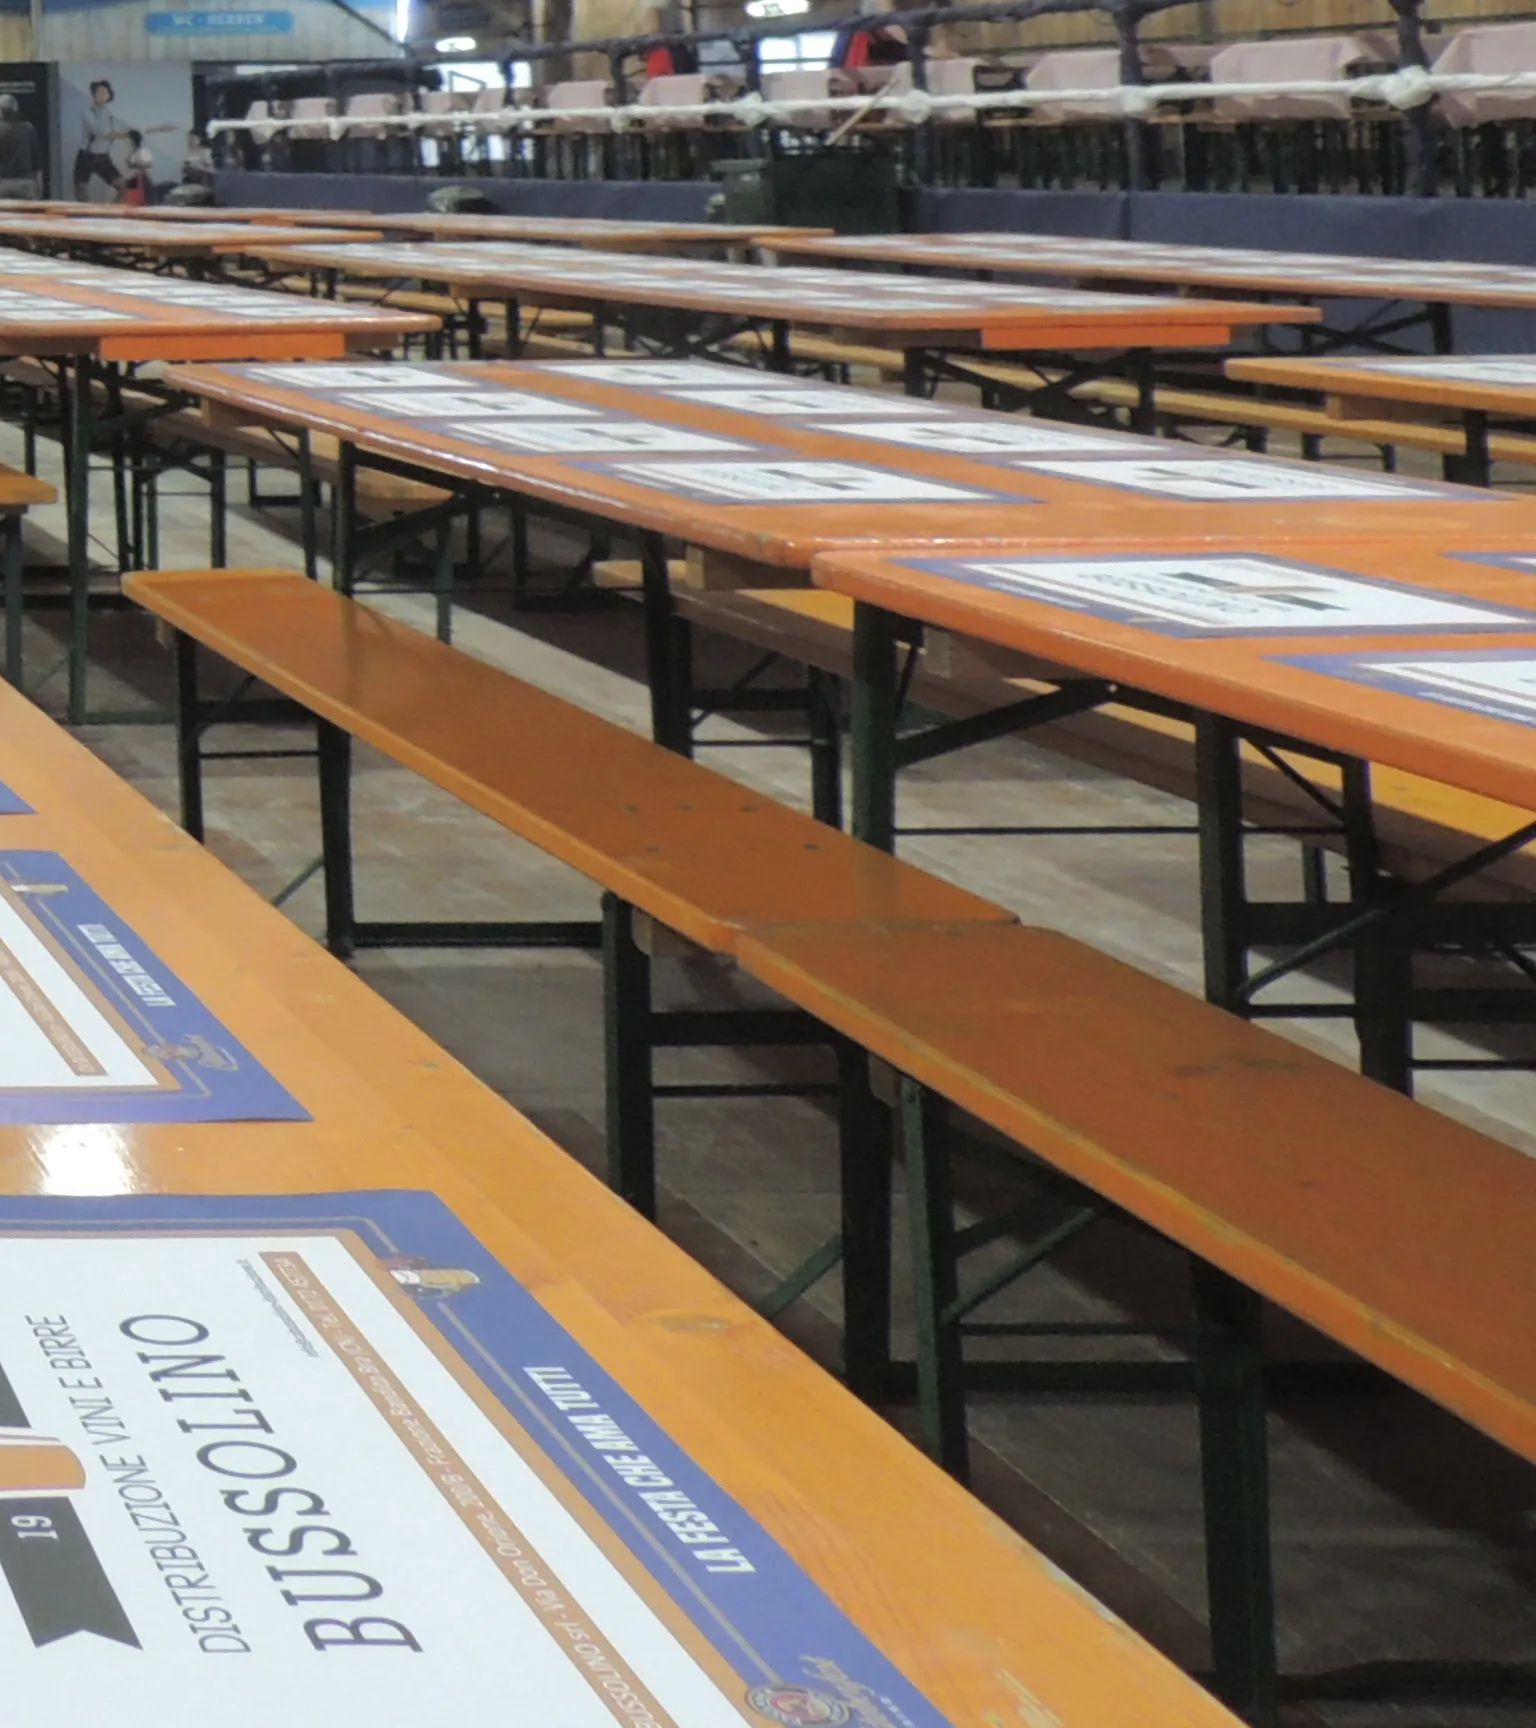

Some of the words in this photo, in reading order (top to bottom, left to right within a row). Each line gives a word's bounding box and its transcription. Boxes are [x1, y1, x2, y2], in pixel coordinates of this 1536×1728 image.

[21, 1314, 99, 1369] BIRRE
[57, 1378, 106, 1388] E
[516, 1365, 608, 1410] TUTTI
[66, 1396, 141, 1444] VINI
[561, 1413, 645, 1451] AMA
[100, 1313, 444, 1652] BUSSOLINO
[598, 1454, 680, 1486] CHE
[7, 1514, 64, 1539] 19
[633, 1490, 738, 1544] FESTA
[91, 1454, 263, 1653] DISTRIBUZIONE
[686, 1548, 762, 1572] LA
[502, 1559, 552, 1585] Don
[525, 1589, 571, 1609] Via
[550, 1620, 594, 1639] srl
